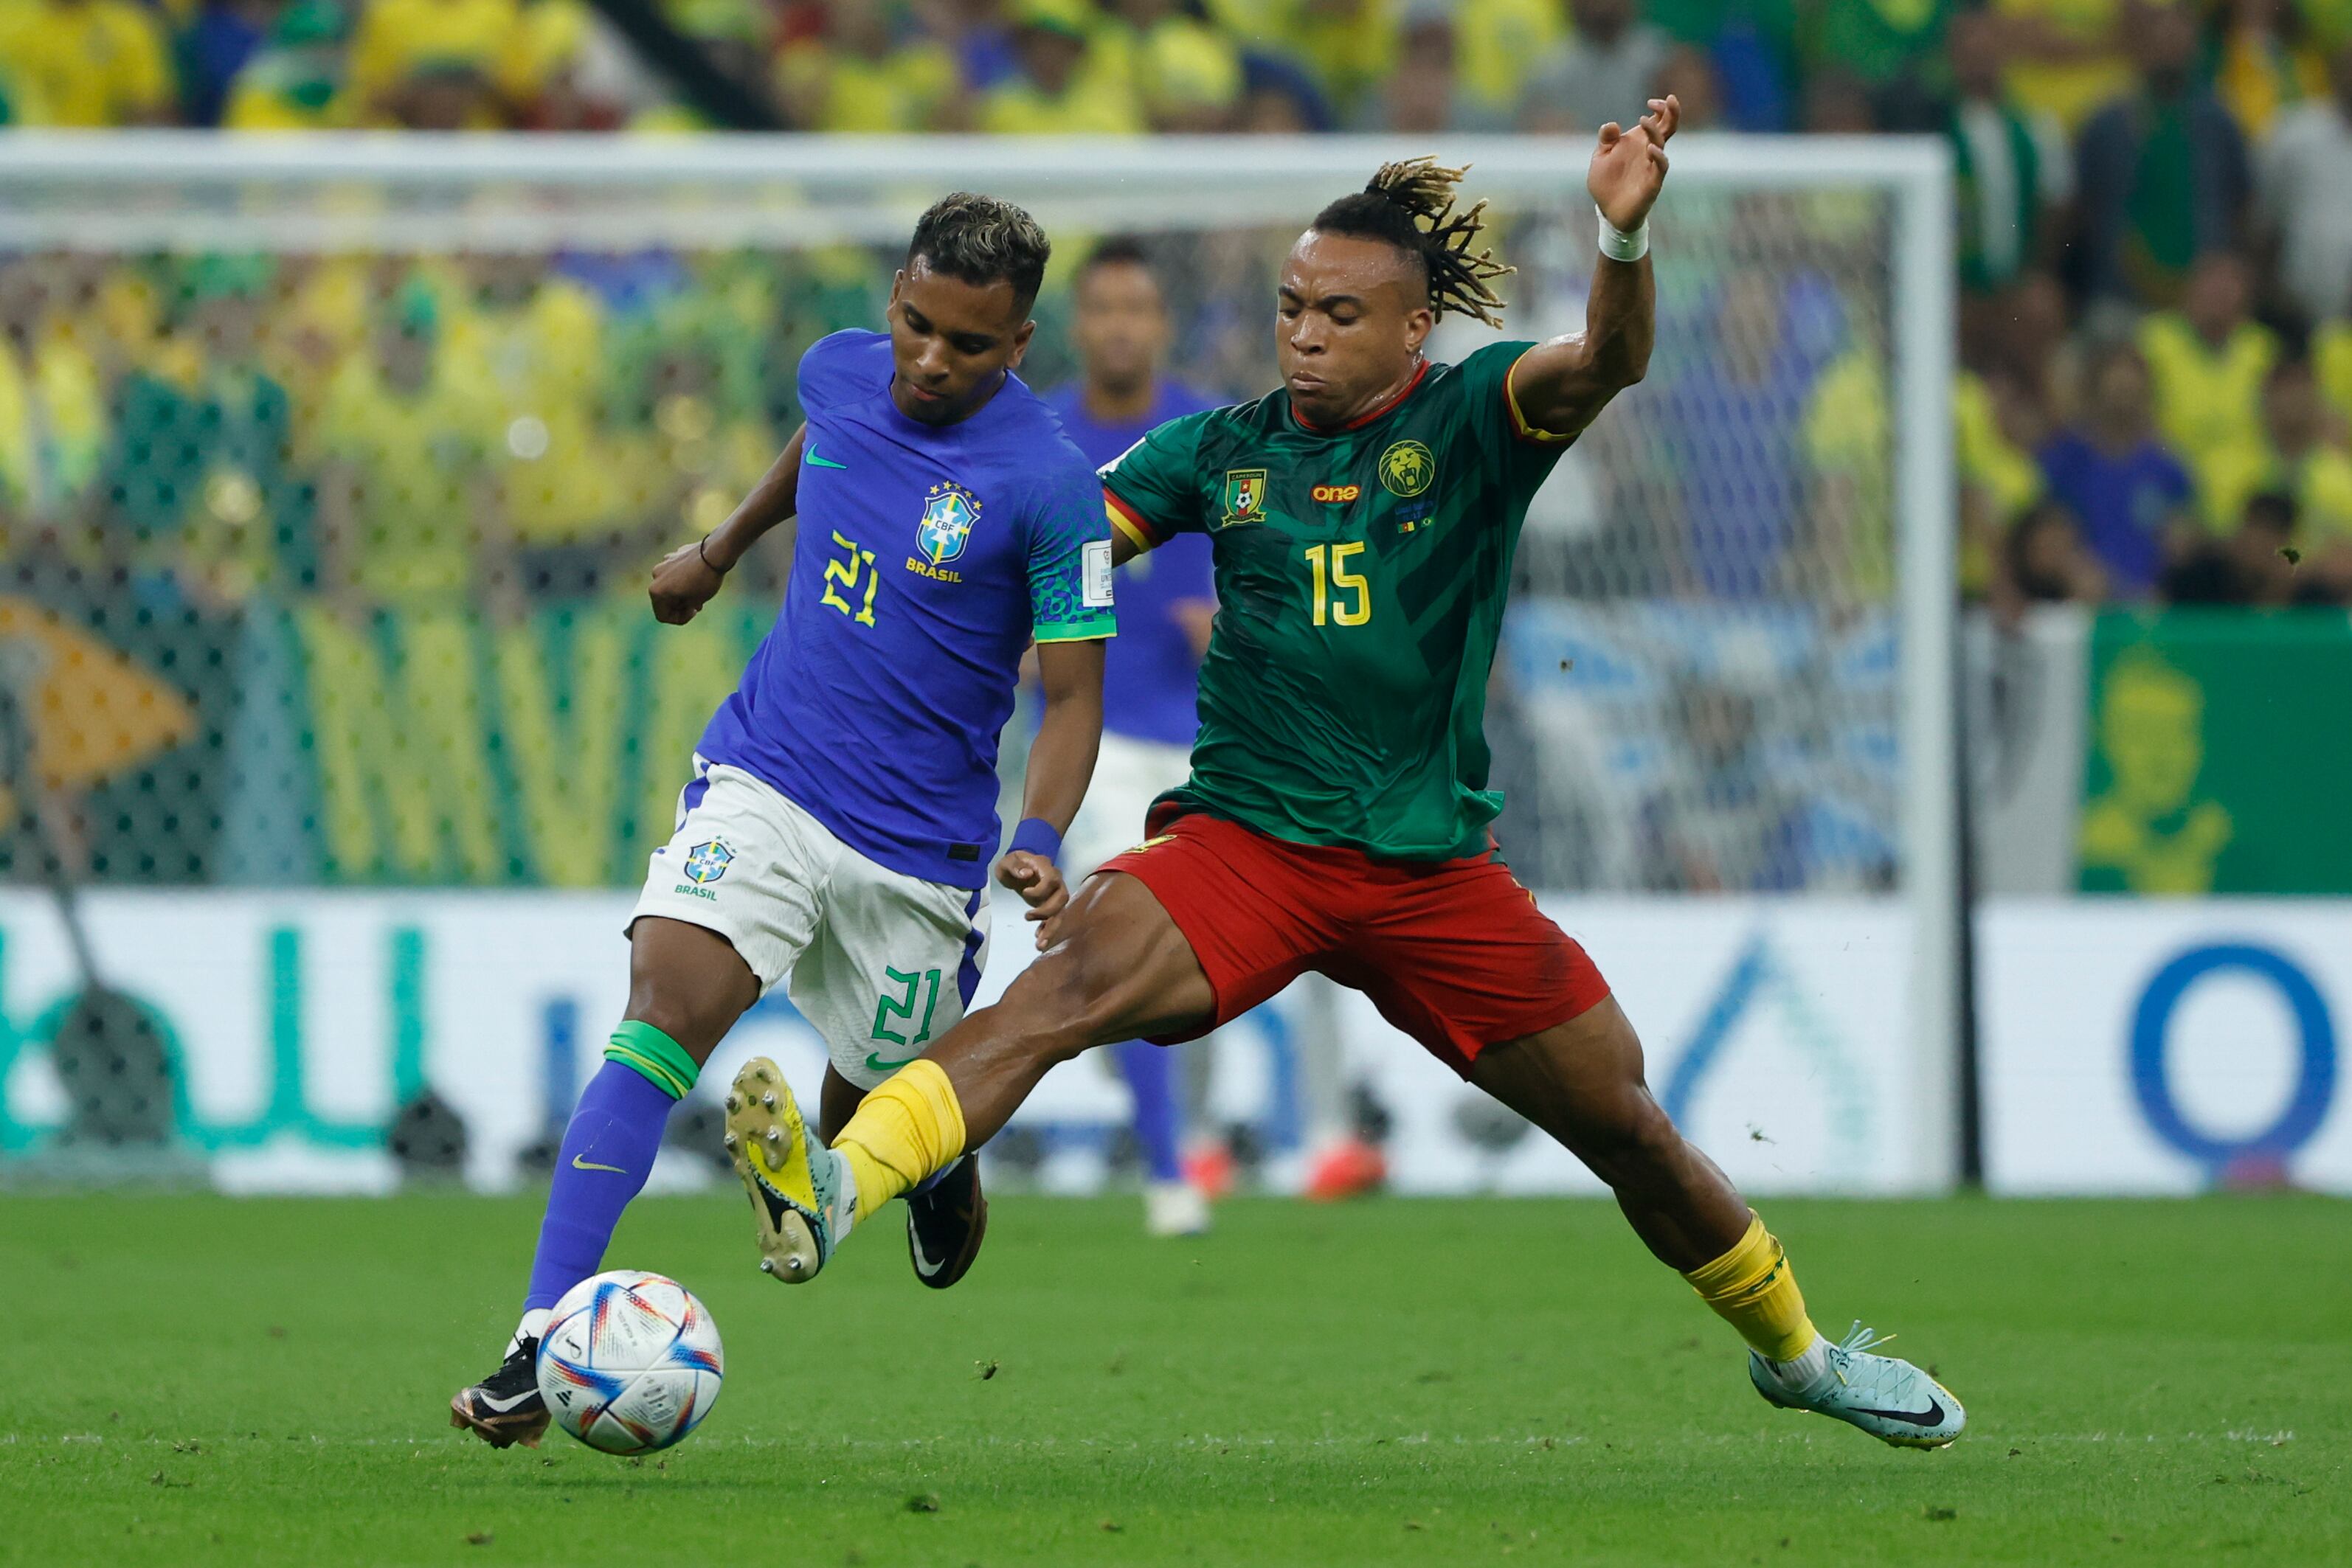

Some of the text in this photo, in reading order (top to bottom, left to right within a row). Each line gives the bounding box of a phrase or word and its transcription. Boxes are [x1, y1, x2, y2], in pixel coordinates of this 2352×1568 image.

[1312, 486, 1359, 502] one
[935, 520, 955, 532] CBF
[819, 529, 878, 628] 21
[905, 557, 962, 583] BRASIL
[1305, 541, 1371, 625] 15
[674, 884, 717, 901] BRASIL
[871, 965, 941, 1046] 21
